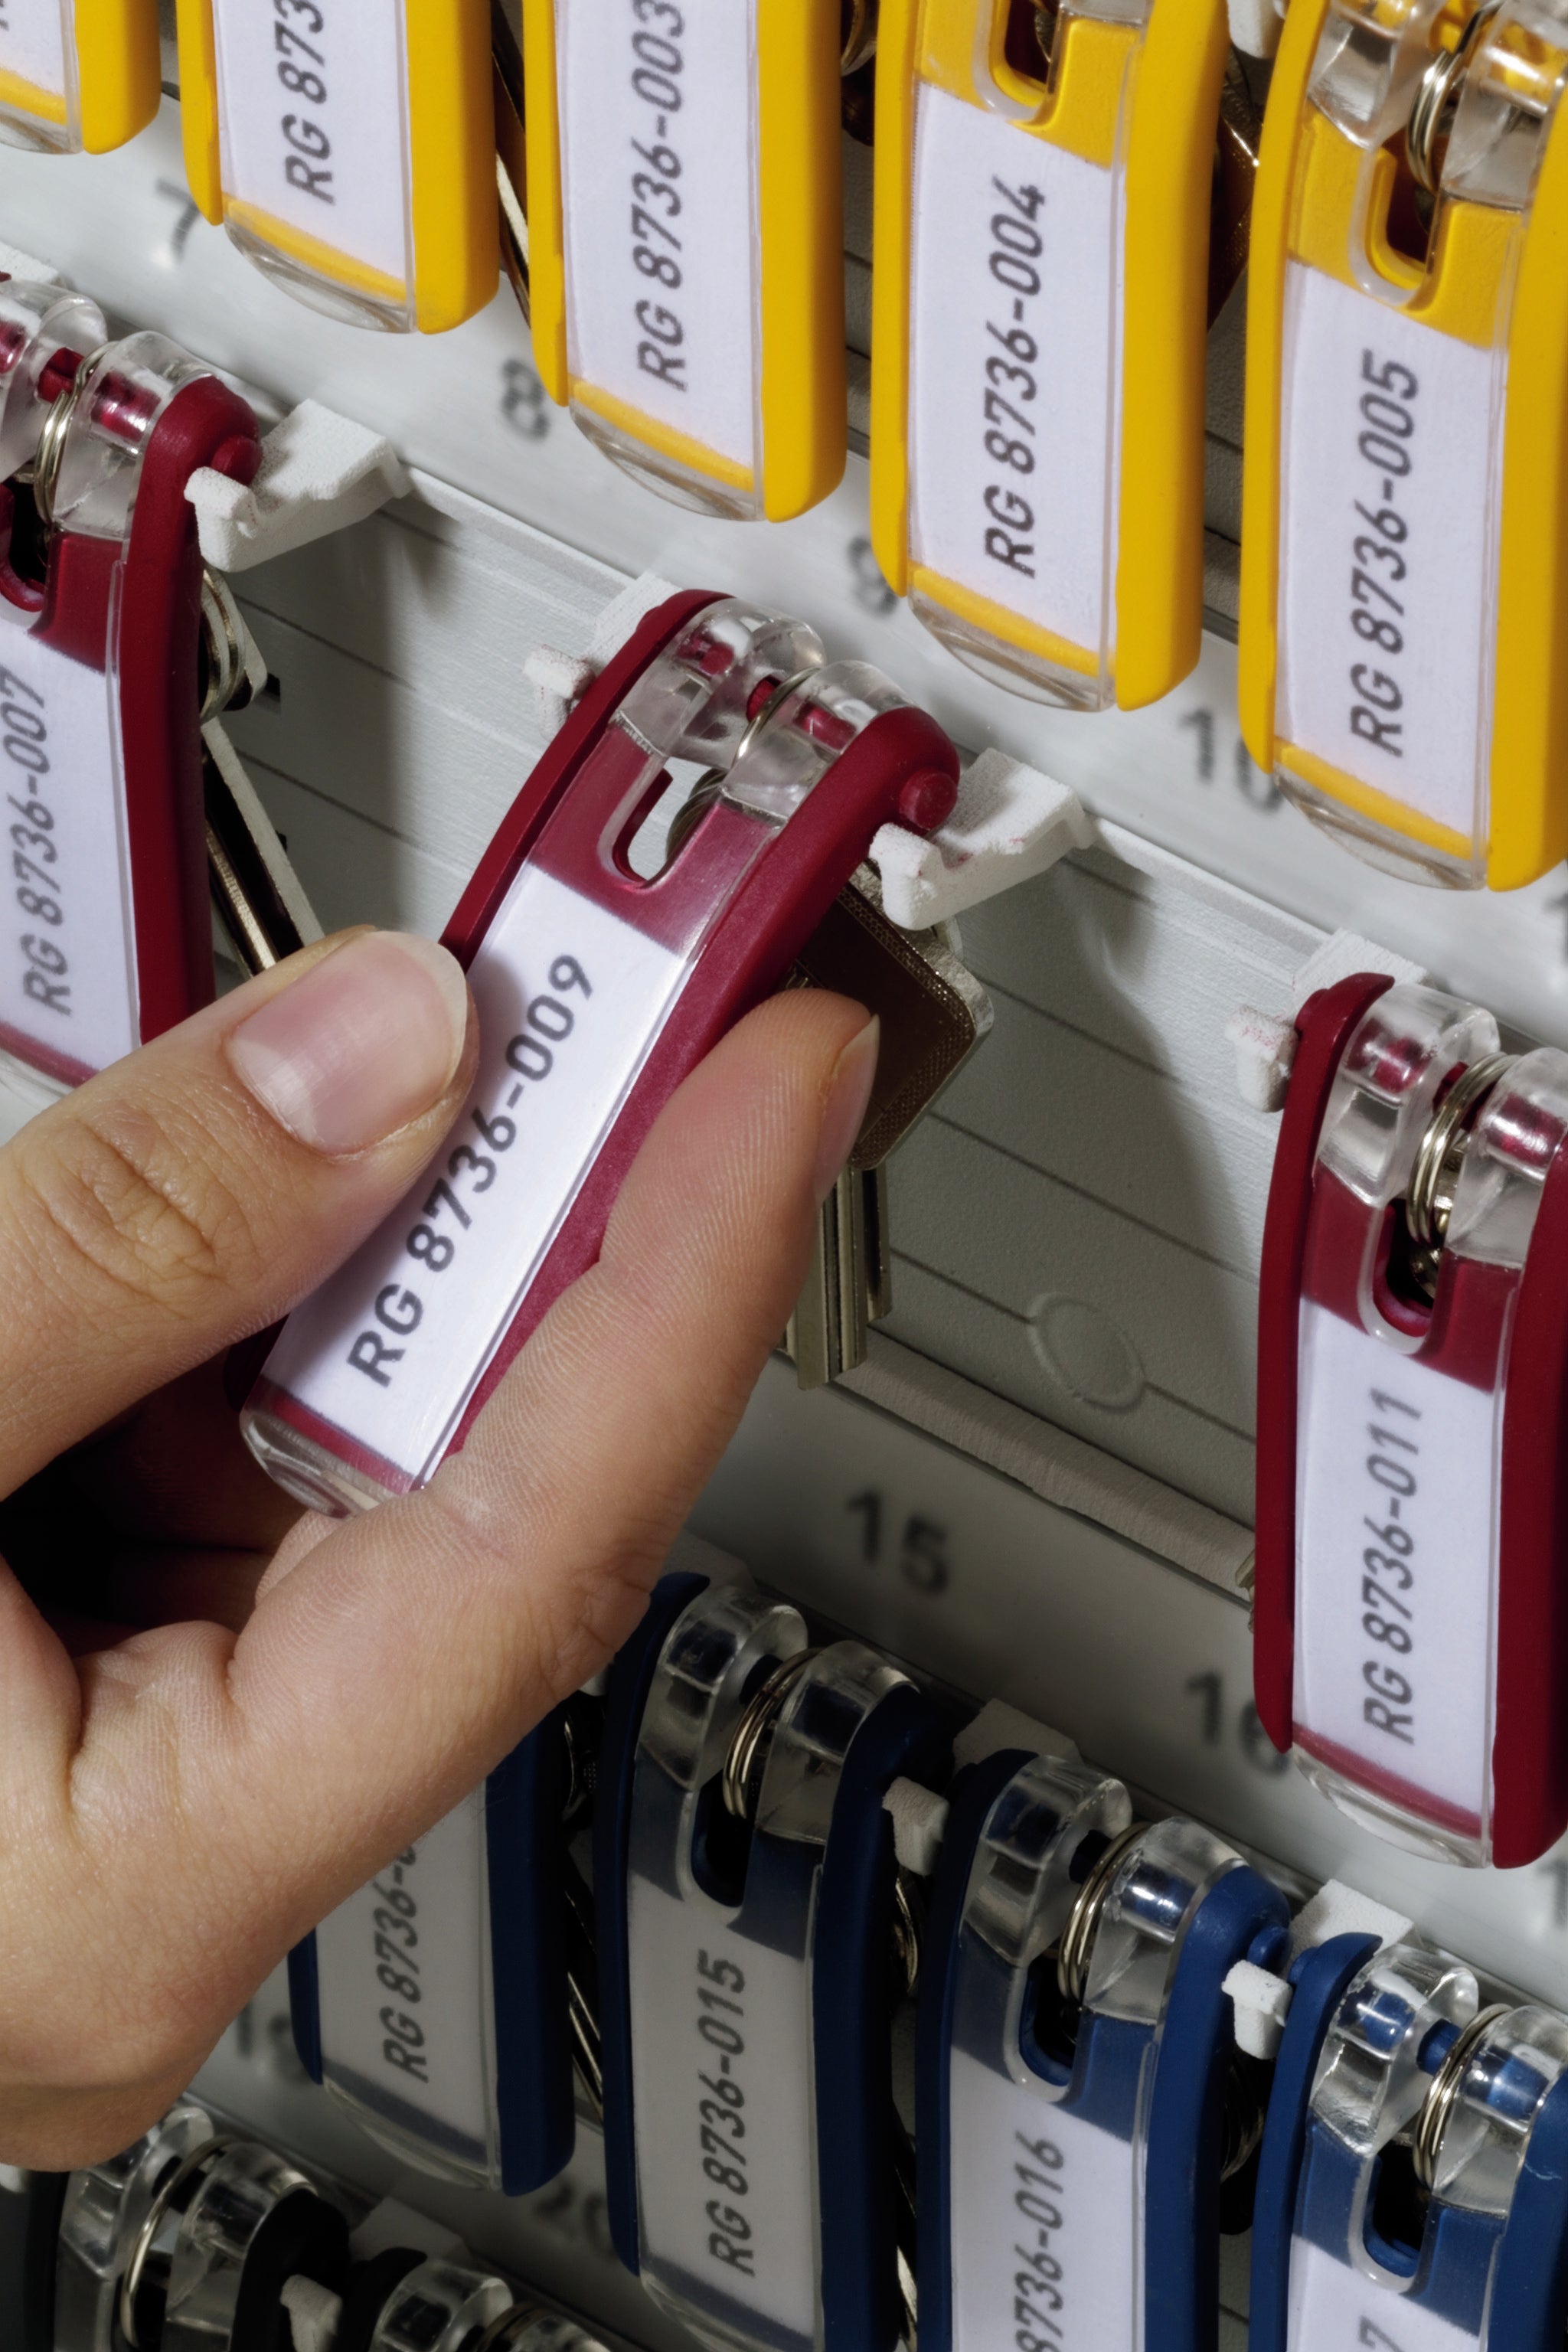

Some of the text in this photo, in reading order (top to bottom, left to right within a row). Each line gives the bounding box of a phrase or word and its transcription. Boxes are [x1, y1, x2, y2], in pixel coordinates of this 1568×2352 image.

[281, 114, 335, 205] RG
[630, 0, 687, 392] RG 8736-003
[983, 176, 1046, 579] RG 8736-004
[1350, 349, 1419, 757] RG 8736-005
[0, 665, 72, 1016] RG 8736-007
[347, 954, 593, 1387] RG 8736-009
[846, 1490, 949, 1595] 15
[1361, 1388, 1422, 1745] RG 8736-011
[379, 2006, 430, 2084] RG
[696, 1949, 755, 2277] RG 8736-015
